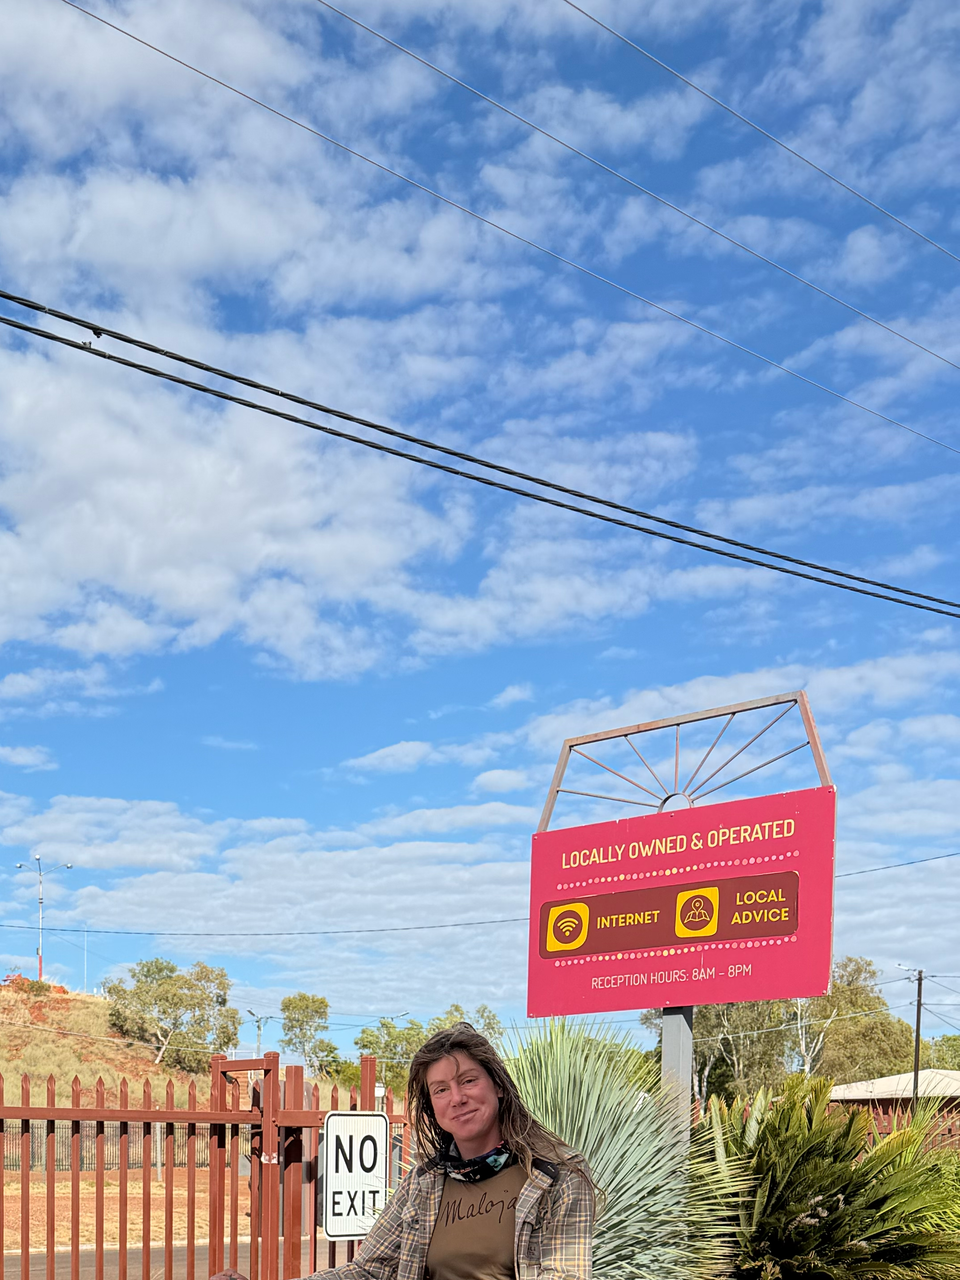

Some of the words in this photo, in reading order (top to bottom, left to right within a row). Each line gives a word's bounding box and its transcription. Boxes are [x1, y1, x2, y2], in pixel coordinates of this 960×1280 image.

[561, 844, 625, 869] LOCALLY
[628, 835, 687, 859] OWNED
[691, 832, 704, 850] &
[707, 819, 795, 848] OPERATED
[736, 888, 786, 905] LOCAL
[596, 910, 660, 929] INTERNET
[731, 908, 790, 925] ADVICE
[591, 973, 648, 989] RECEPTION
[650, 969, 689, 984] HOURS:
[692, 966, 715, 981] 8AM
[728, 964, 752, 978] 8PM
[334, 1134, 378, 1174] NO
[332, 1190, 380, 1217] EXIT
[441, 1189, 517, 1227] Maloja
